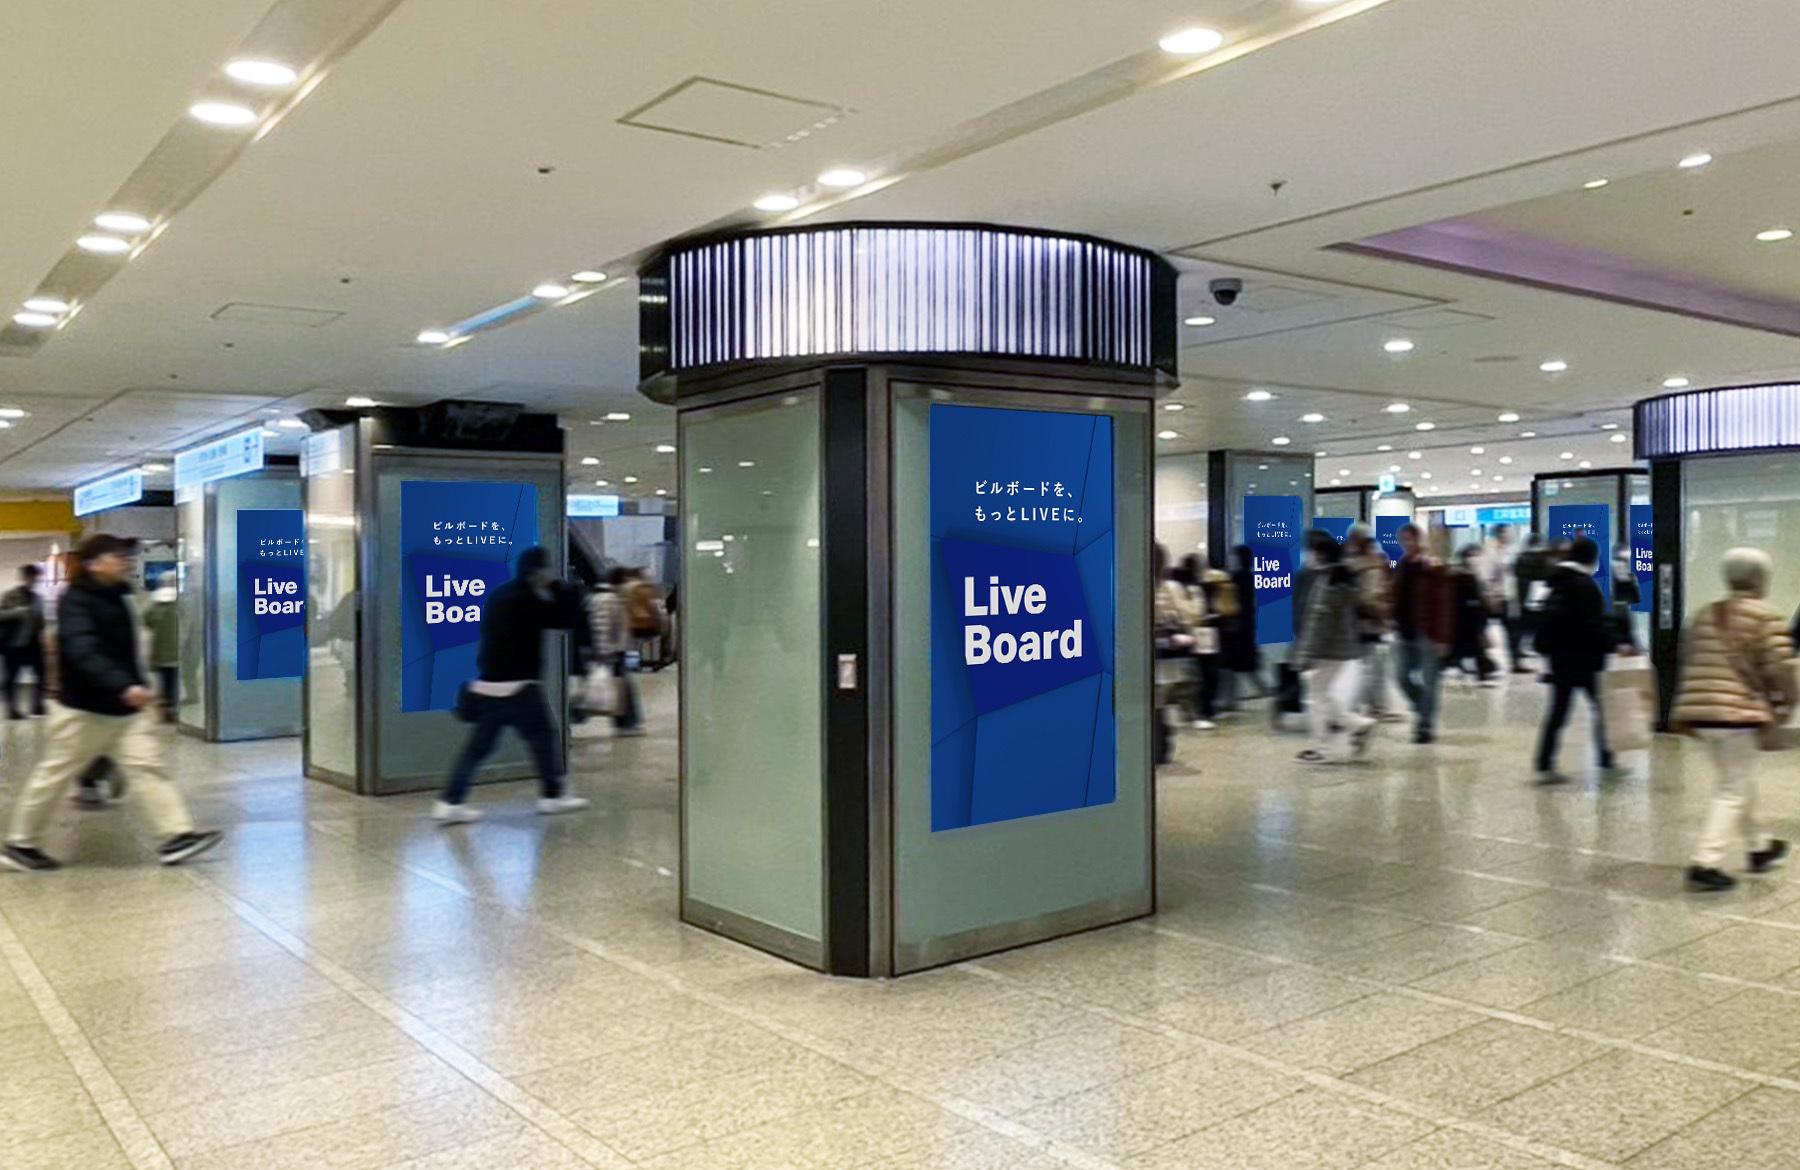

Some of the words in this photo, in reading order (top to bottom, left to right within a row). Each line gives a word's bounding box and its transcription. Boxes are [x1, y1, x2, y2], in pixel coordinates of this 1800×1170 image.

[976, 480, 1072, 497] ビルボードを、
[976, 506, 1082, 522] もっとLIVEに。
[434, 521, 504, 531] ビルボードを、
[434, 536, 512, 545] もっとLIVEに。
[259, 548, 305, 557] もっとLIVE
[1254, 557, 1279, 571] Live
[255, 578, 297, 595] Live
[426, 575, 485, 597] Live
[1255, 573, 1290, 589] Board
[965, 576, 1046, 616] Live
[255, 598, 303, 614] Boar
[426, 602, 480, 624] Boa
[965, 620, 1082, 665] Board
